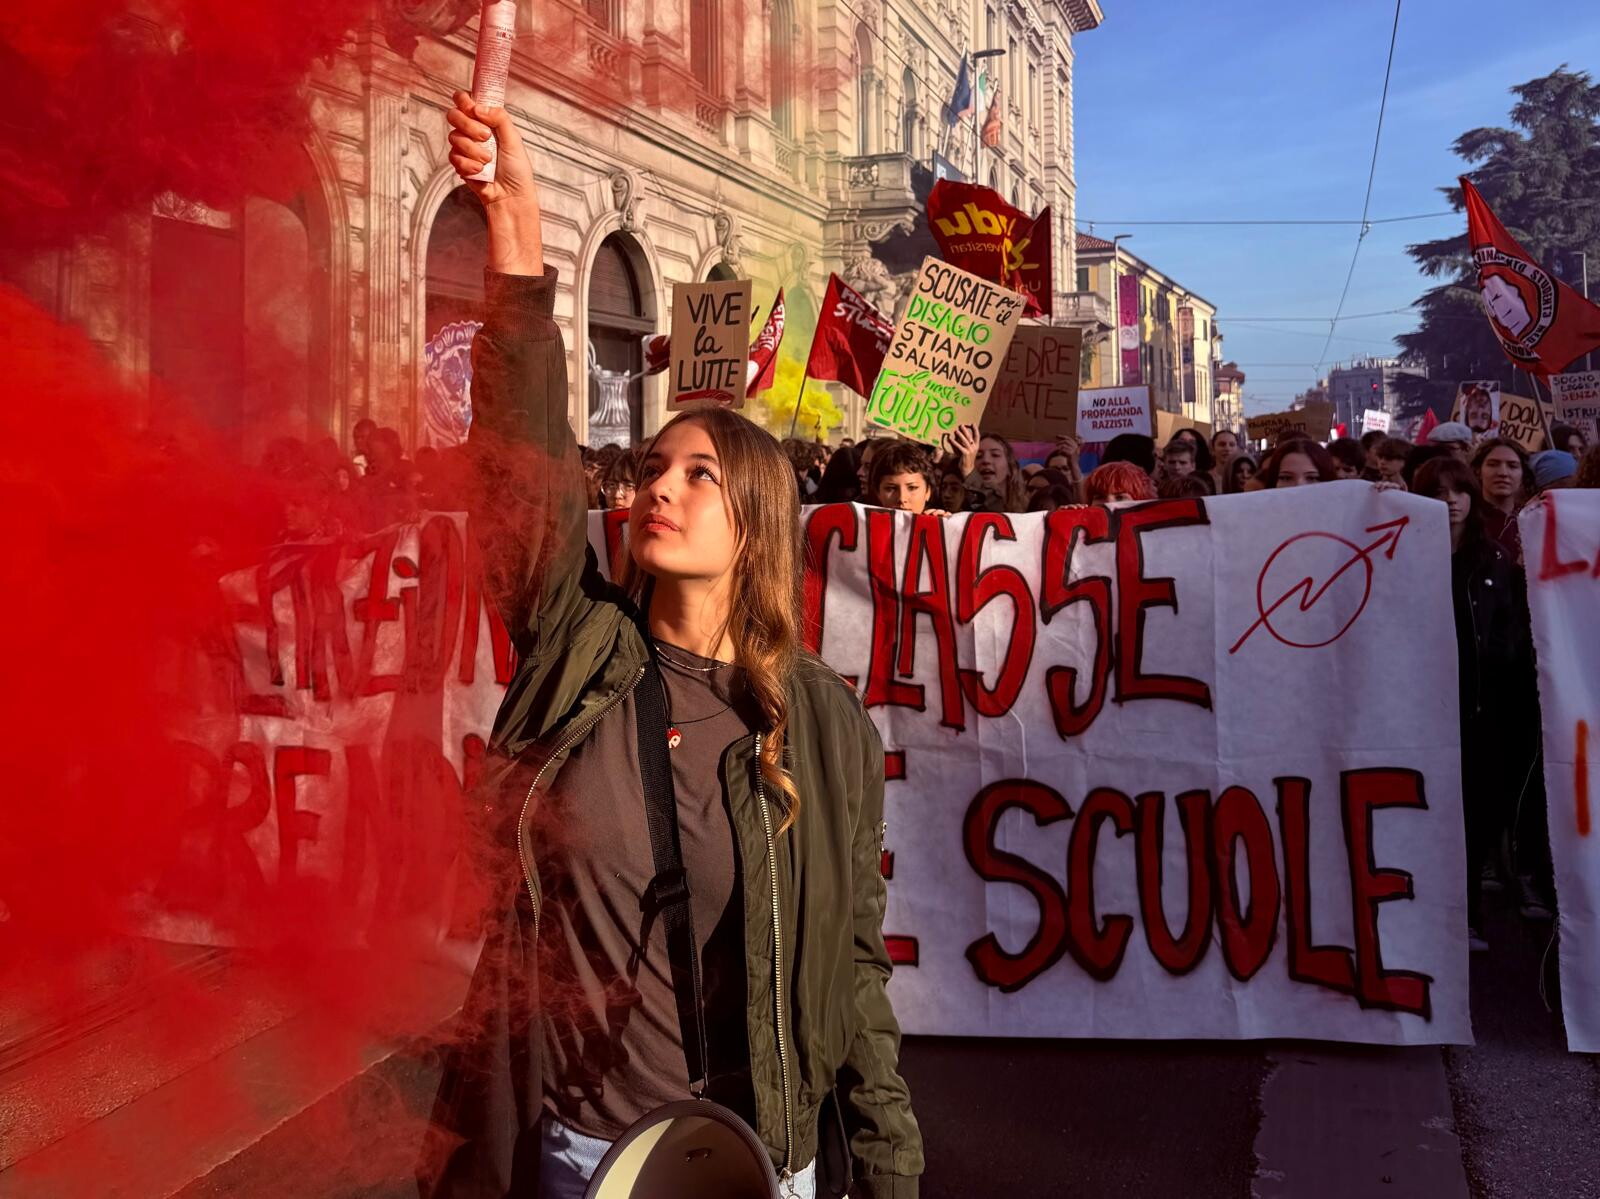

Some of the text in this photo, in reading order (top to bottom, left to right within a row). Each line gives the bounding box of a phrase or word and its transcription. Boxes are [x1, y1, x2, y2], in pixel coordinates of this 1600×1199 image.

[686, 291, 743, 326] VIVE
[919, 263, 1000, 320] SCUSATE
[994, 295, 1021, 310] per
[907, 294, 992, 346] DISAGIO
[996, 311, 1012, 327] il
[694, 325, 723, 357] la
[900, 321, 993, 370] STIAMO
[677, 359, 740, 392] LUTTE
[891, 342, 987, 394] SALVANDO
[867, 367, 956, 439] FUTURO
[1081, 407, 1143, 420] PROPAGANDA
[1092, 396, 1130, 408] NO ALLA
[1091, 418, 1134, 430] RAZZISTA
[801, 498, 1212, 742] CLASSE
[962, 767, 1433, 1022] SCUOLE
